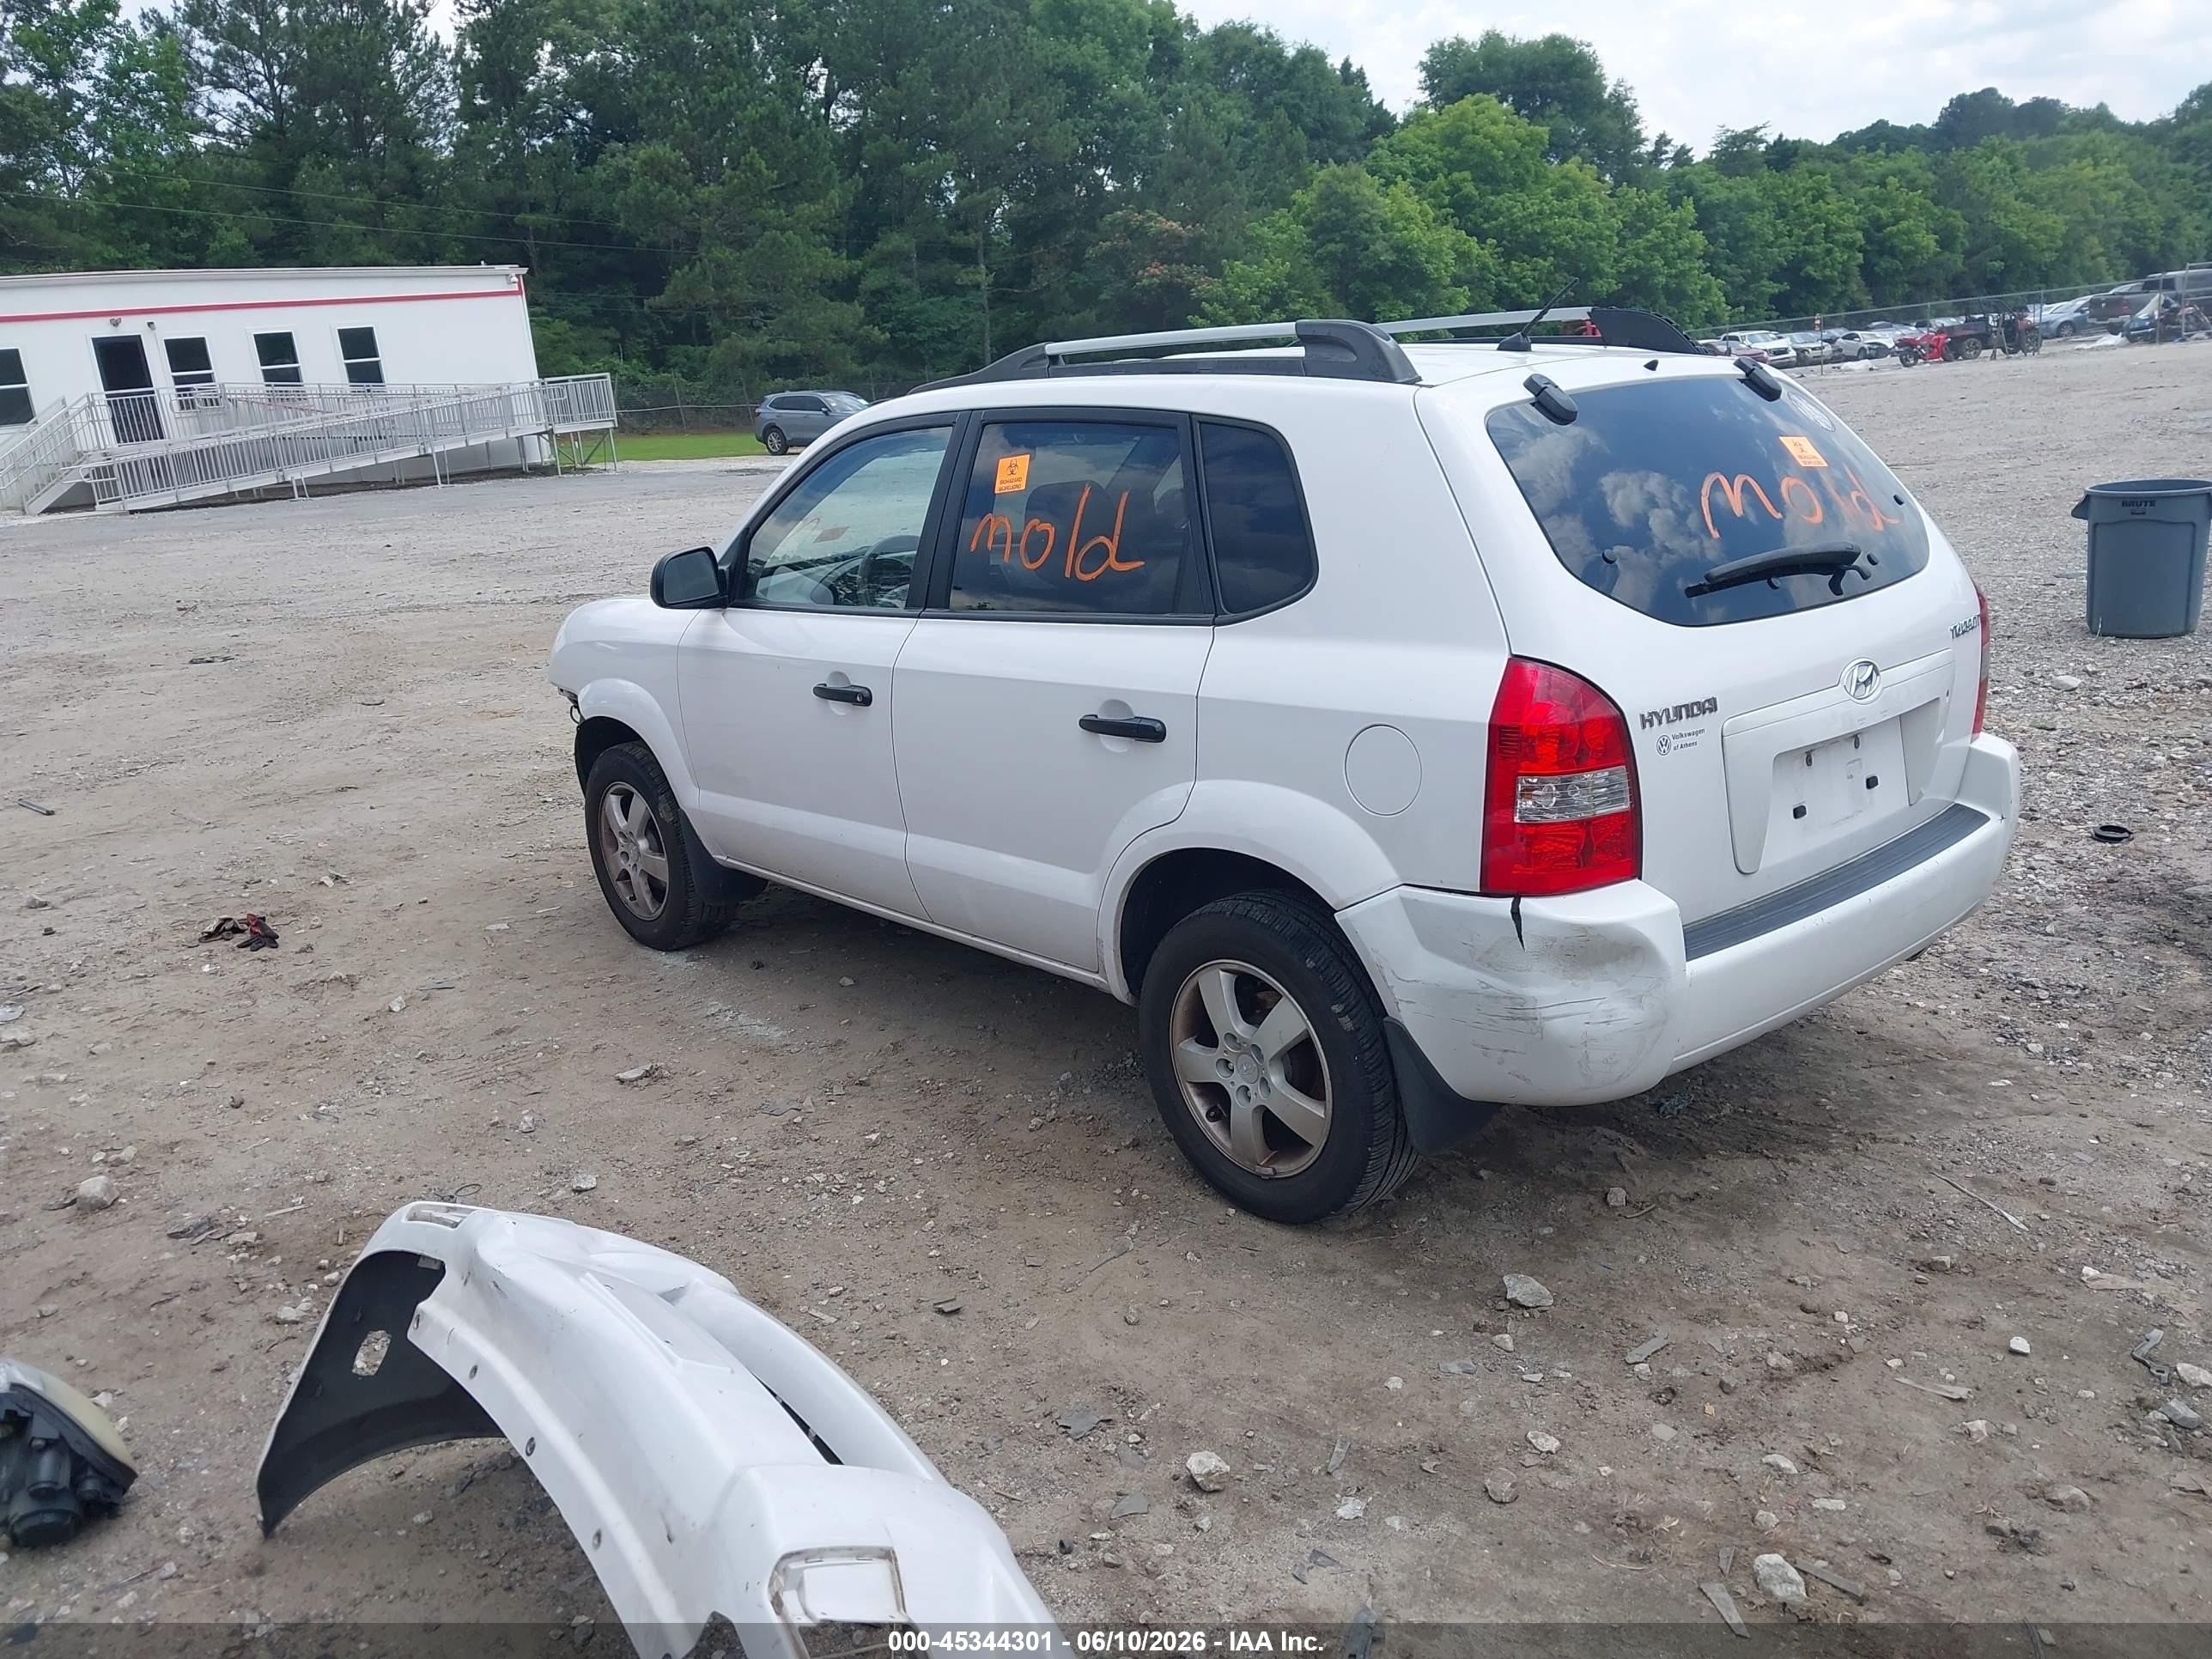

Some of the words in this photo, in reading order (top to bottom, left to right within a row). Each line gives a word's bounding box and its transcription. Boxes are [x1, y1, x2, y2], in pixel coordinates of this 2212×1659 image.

[969, 481, 1146, 582] mold
[1639, 696, 1717, 730] HYUNDAI
[1671, 728, 1705, 741] Volkswagen
[1680, 741, 1698, 750] Athens
